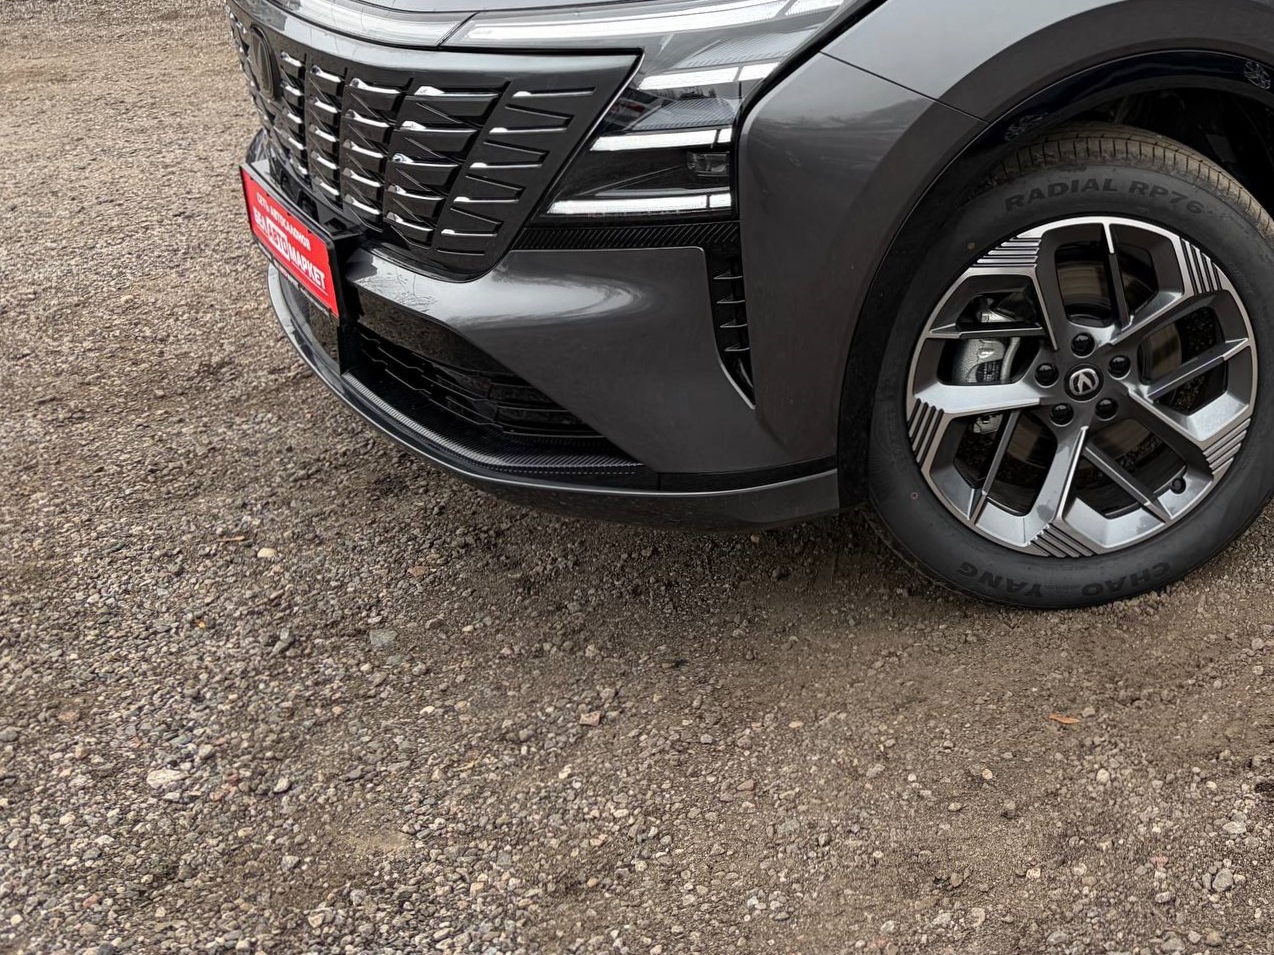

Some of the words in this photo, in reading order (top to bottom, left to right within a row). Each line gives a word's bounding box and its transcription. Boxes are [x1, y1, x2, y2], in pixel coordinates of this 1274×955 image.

[1004, 177, 1118, 212] RADIAL
[1128, 180, 1206, 214] RP76
[958, 561, 1044, 598] YANG
[1081, 561, 1172, 597] CHAO
